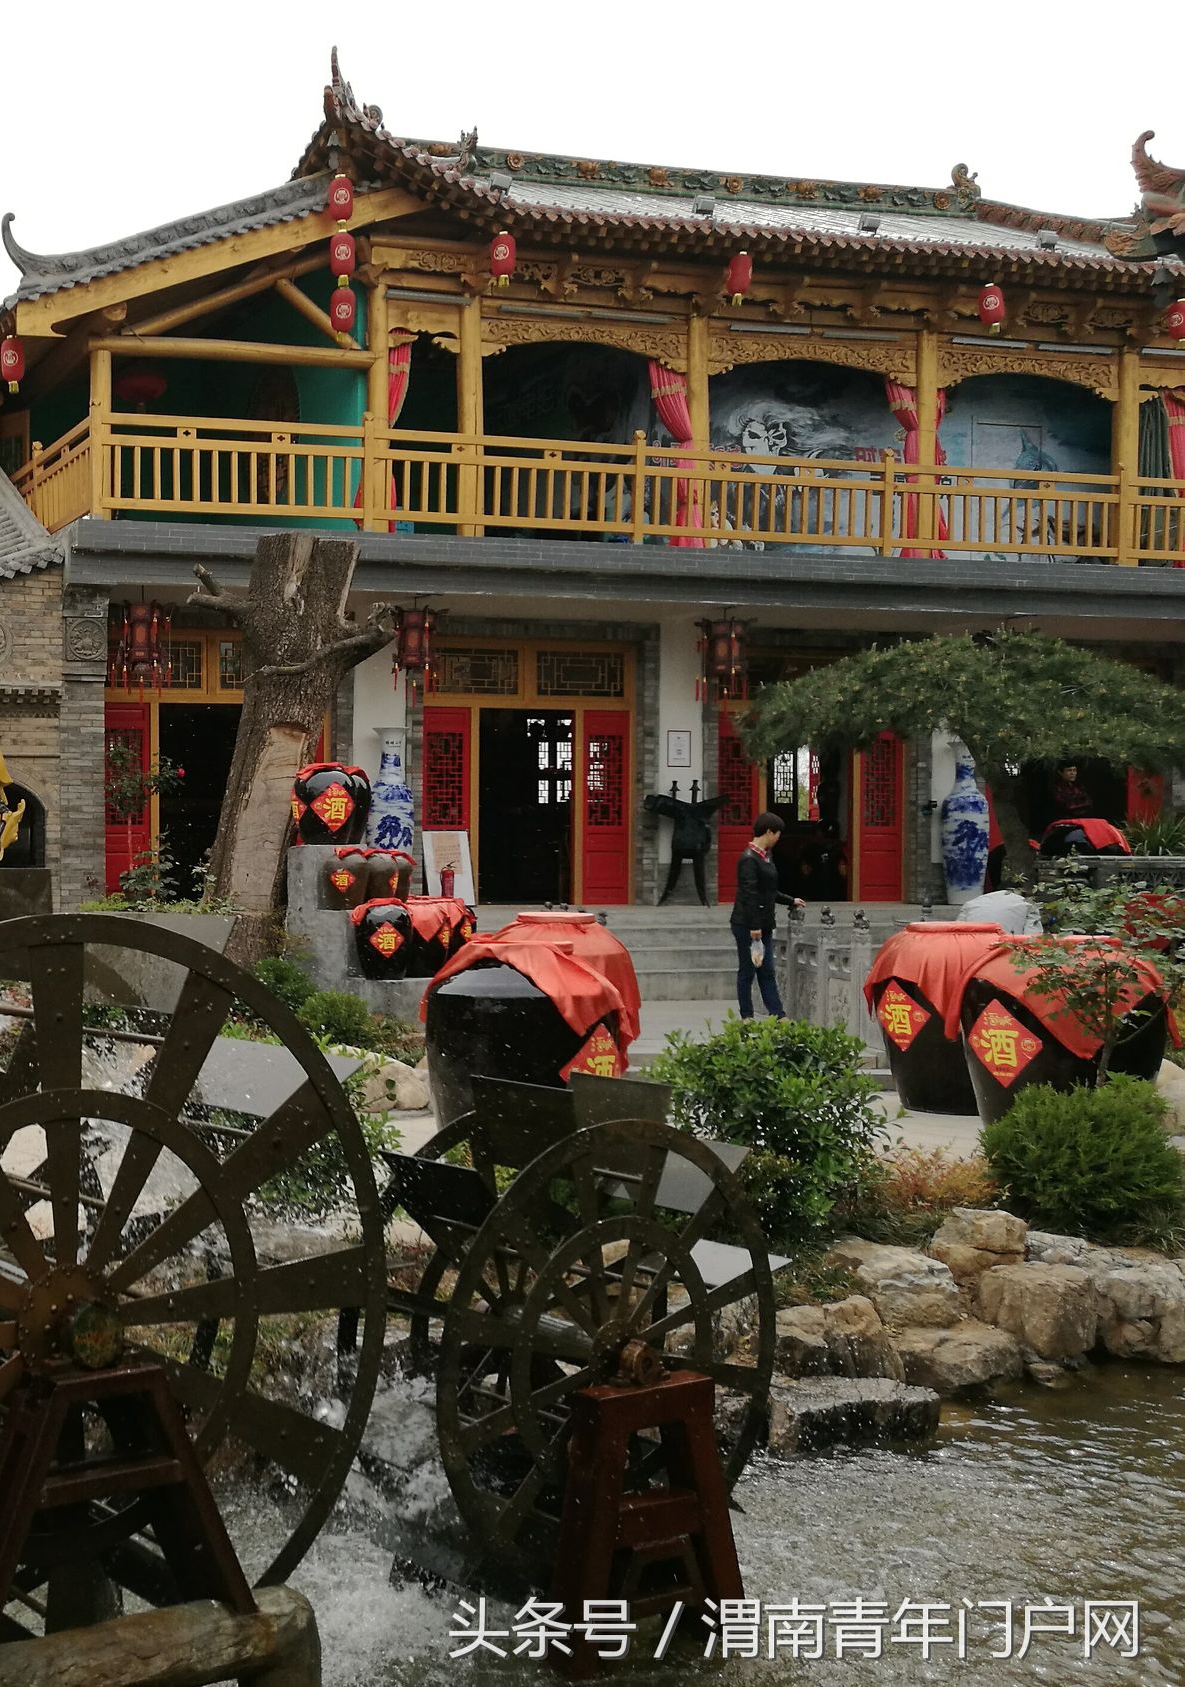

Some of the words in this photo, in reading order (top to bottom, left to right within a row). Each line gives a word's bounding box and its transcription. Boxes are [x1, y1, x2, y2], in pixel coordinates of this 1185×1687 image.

[322, 797, 348, 820] 酒
[377, 933, 396, 950] 酒
[884, 1004, 912, 1034] 酒
[980, 1029, 1019, 1067] 酒
